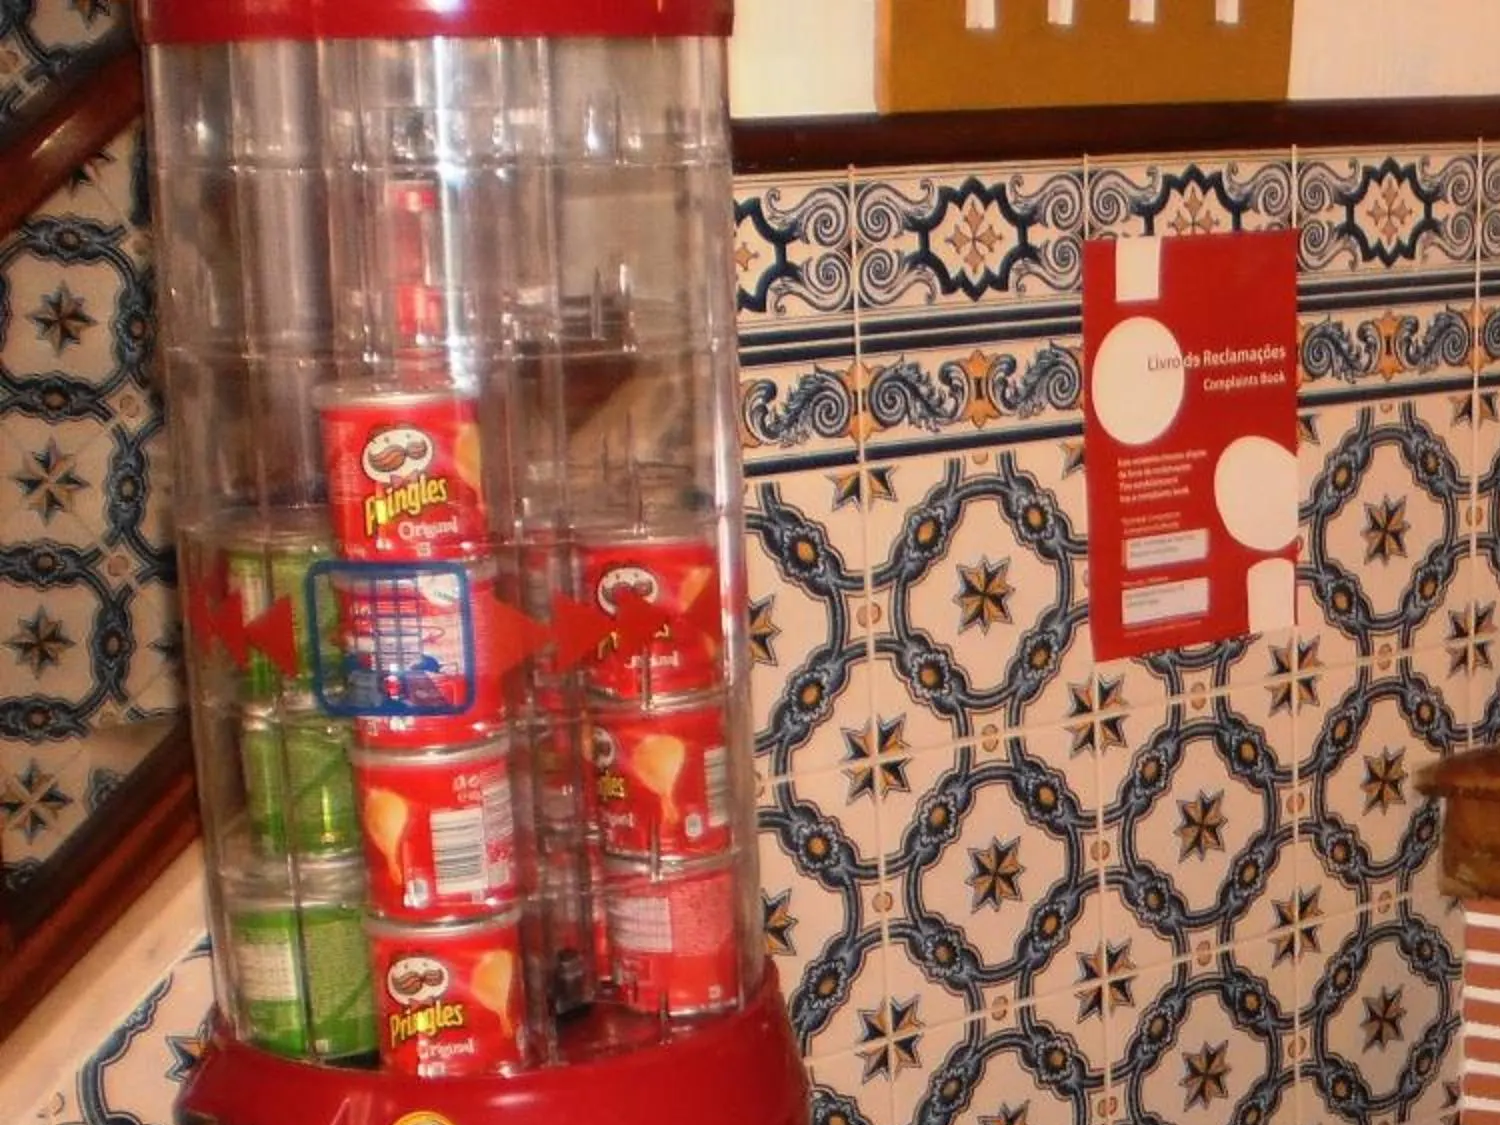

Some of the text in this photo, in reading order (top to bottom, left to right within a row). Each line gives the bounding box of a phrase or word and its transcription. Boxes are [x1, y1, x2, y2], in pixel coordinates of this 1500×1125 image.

[1147, 344, 1286, 371] Livro de Reclamações
[1203, 370, 1286, 392] Complaints Book
